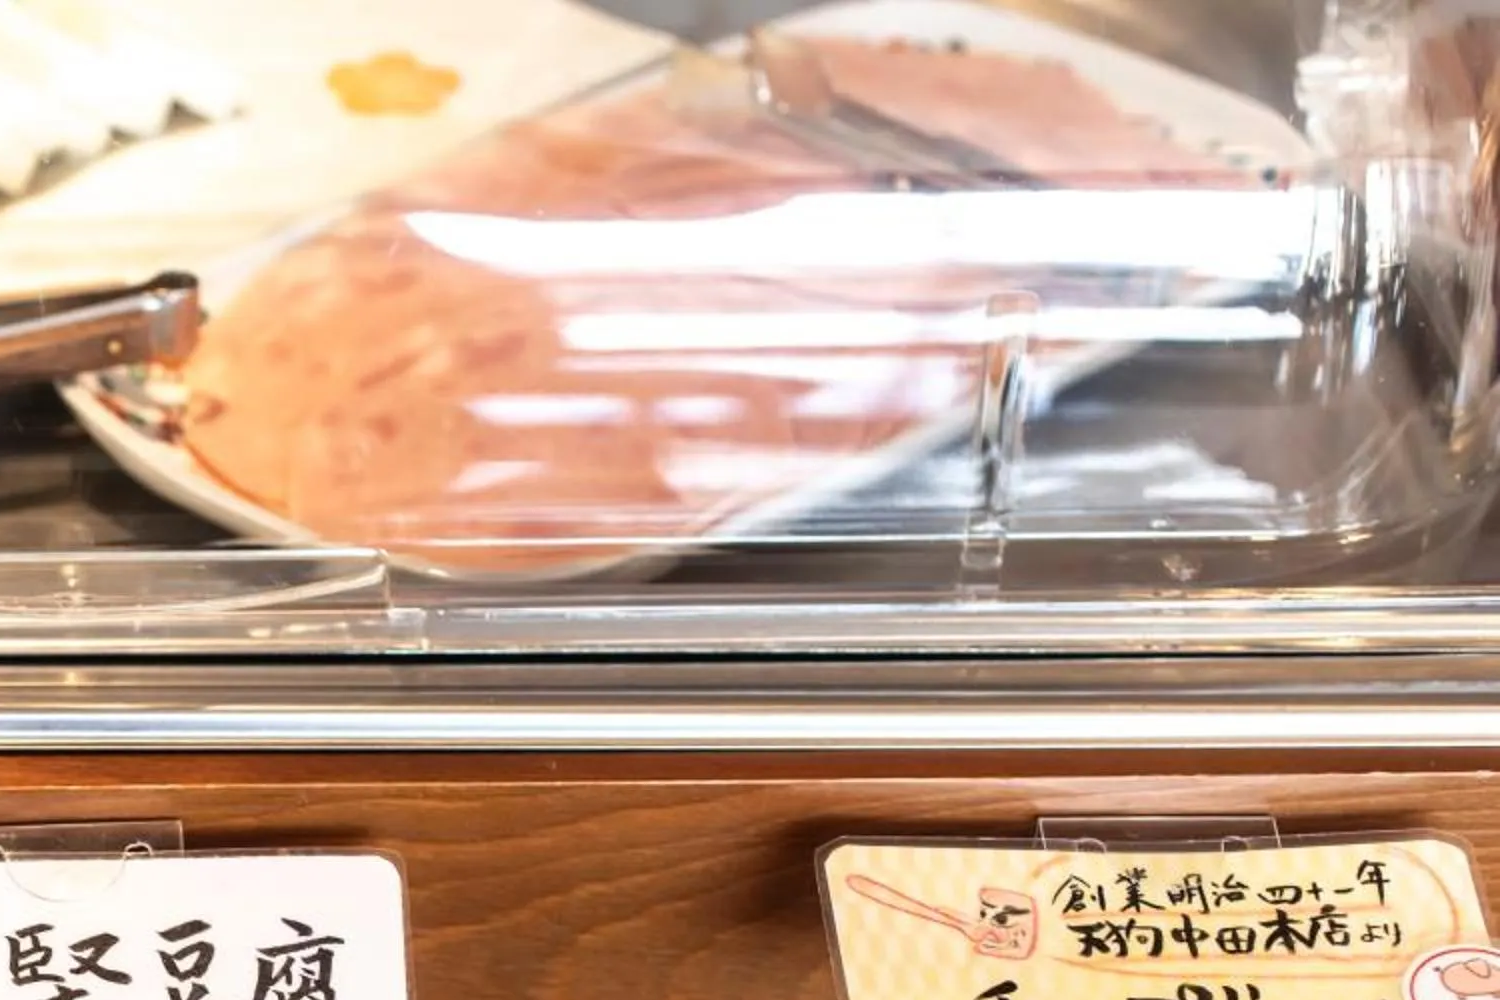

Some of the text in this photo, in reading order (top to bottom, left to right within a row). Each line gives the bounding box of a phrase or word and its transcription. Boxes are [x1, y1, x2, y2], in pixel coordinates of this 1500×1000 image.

[1051, 859, 1390, 913] 創業明治四十一年
